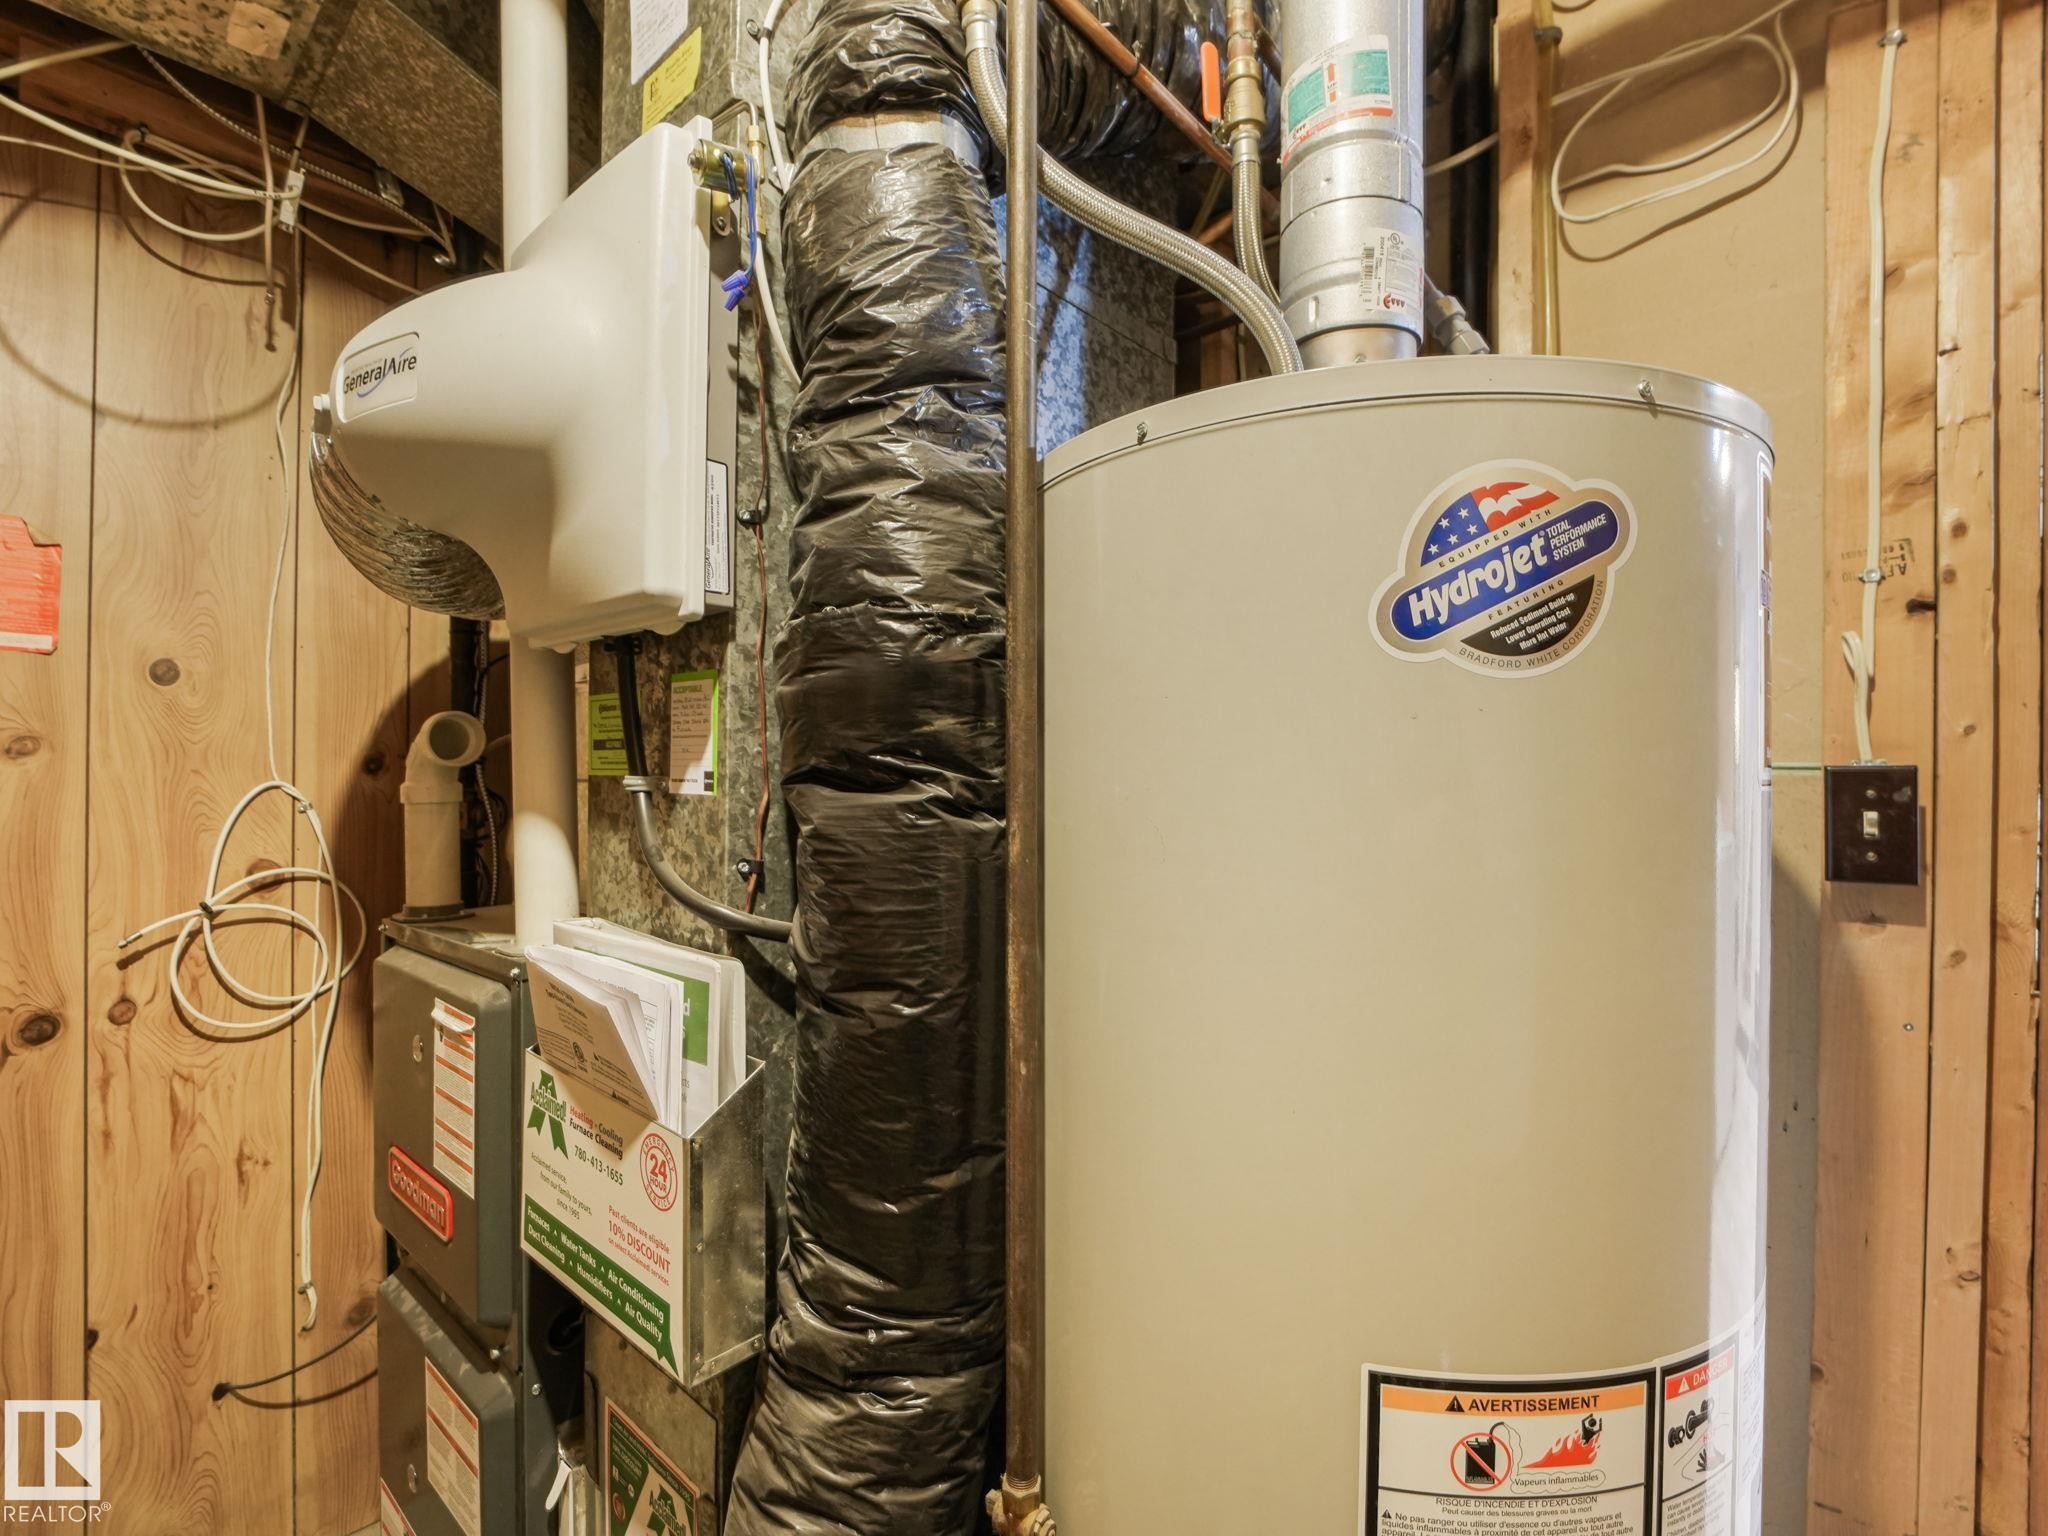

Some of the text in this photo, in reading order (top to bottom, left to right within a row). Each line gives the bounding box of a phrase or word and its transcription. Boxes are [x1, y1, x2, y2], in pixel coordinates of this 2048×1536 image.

[343, 355, 417, 394] GeneralAire
[1438, 509, 1552, 568] EQUIPPED WITH
[1545, 519, 1572, 538] TOTAL
[1550, 513, 1607, 550] PERFORMANCE
[1552, 537, 1585, 561] SYSTEM
[1408, 533, 1548, 627] Hydrojet
[1487, 580, 1565, 621] FEATURING
[1490, 592, 1576, 640] Reduced Sediment Build-up
[1458, 579, 1604, 668] BRADFORD WHITE CORPORATION
[1505, 606, 1572, 645] Lower Operating Cost
[1519, 621, 1567, 651] More Hot Water
[569, 1105, 594, 1130] Heating
[598, 1122, 623, 1147] Cooling
[569, 1117, 623, 1161] Furnace Cleaning
[574, 1144, 624, 1186] 780-413-1655
[642, 1137, 675, 1172] EMERGENCY
[649, 1153, 668, 1183] 24
[391, 1157, 446, 1230] Goodman
[645, 1183, 671, 1208] SERVICE
[649, 1174, 667, 1194] HOUR
[608, 1204, 670, 1254] Past clients are eligible
[608, 1220, 671, 1274] 10% DISCOUNT
[527, 1205, 664, 1324] Furnaces Water Tanks Air Conditioning
[528, 1223, 663, 1342] Duct Cleaning Humidifiers Air Quality
[614, 1241, 627, 1255] select
[650, 1268, 670, 1286] services
[1692, 1357, 1729, 1387] DANGER
[1468, 1395, 1600, 1412] AVERTISSEMENT
[1514, 1474, 1599, 1487] Vapeurs inflammables
[1395, 1512, 1408, 1521] Ne
[1410, 1515, 1425, 1524] pas
[1427, 1517, 1455, 1527] ranger
[1469, 1519, 1497, 1528] utiliser
[1499, 1520, 1539, 1529] d'essence
[1553, 1518, 1583, 1527] d'autres
[1584, 1514, 1614, 1525] vapeurs
[1436, 1496, 1598, 1509] RISQUE D'INCENDIE ET D'EXPLOSION
[1441, 1507, 1459, 1515] Peut
[1486, 1509, 1500, 1517] des
[1536, 1510, 1559, 1518] graves
[1381, 1518, 1414, 1530] liquides
[1416, 1524, 1472, 1535] inflammables
[1546, 1524, 1578, 1536] appareil
[1578, 1525, 1589, 1533] ou
[1590, 1522, 1604, 1531] tout
[1606, 1520, 1624, 1530] autre
[1615, 1526, 1634, 1536] autre
